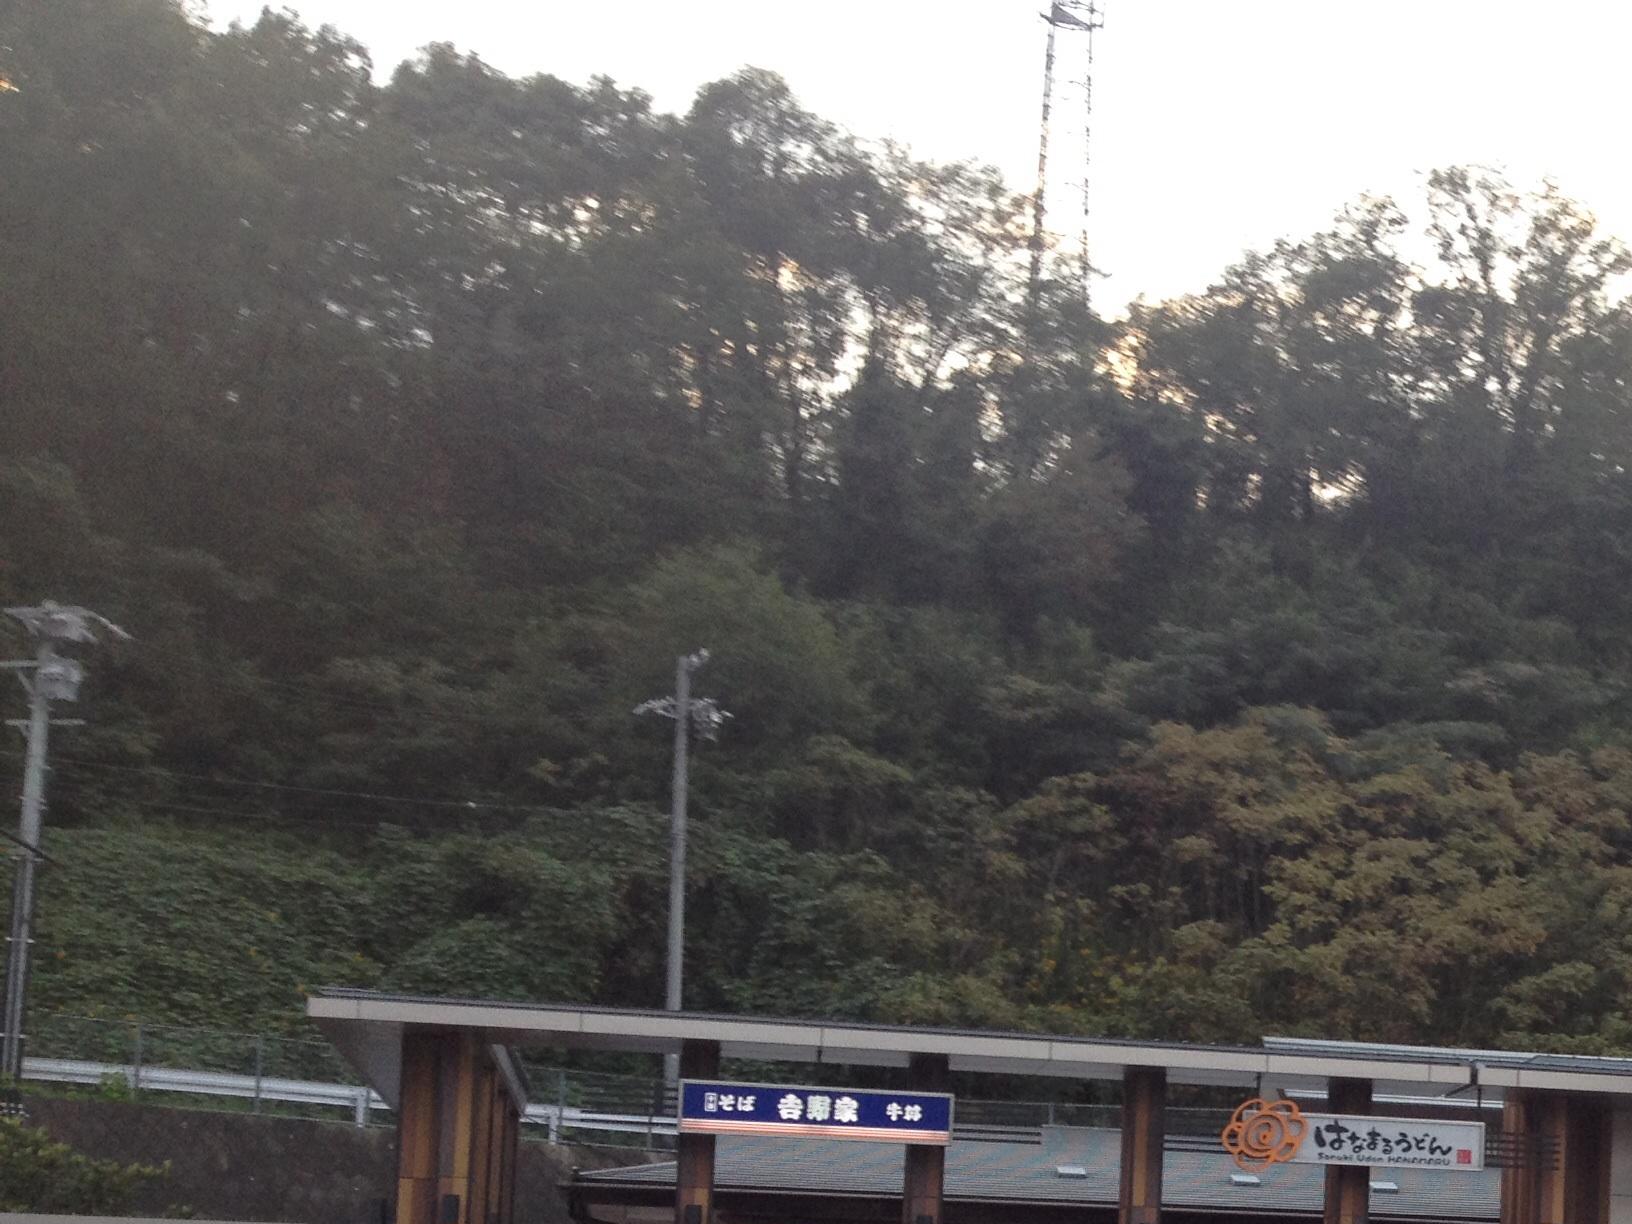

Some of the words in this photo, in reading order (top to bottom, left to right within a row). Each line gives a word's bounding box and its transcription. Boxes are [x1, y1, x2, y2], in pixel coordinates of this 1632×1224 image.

[886, 1102, 922, 1121] 牛丼
[1314, 1119, 1452, 1156] はなまるうどん
